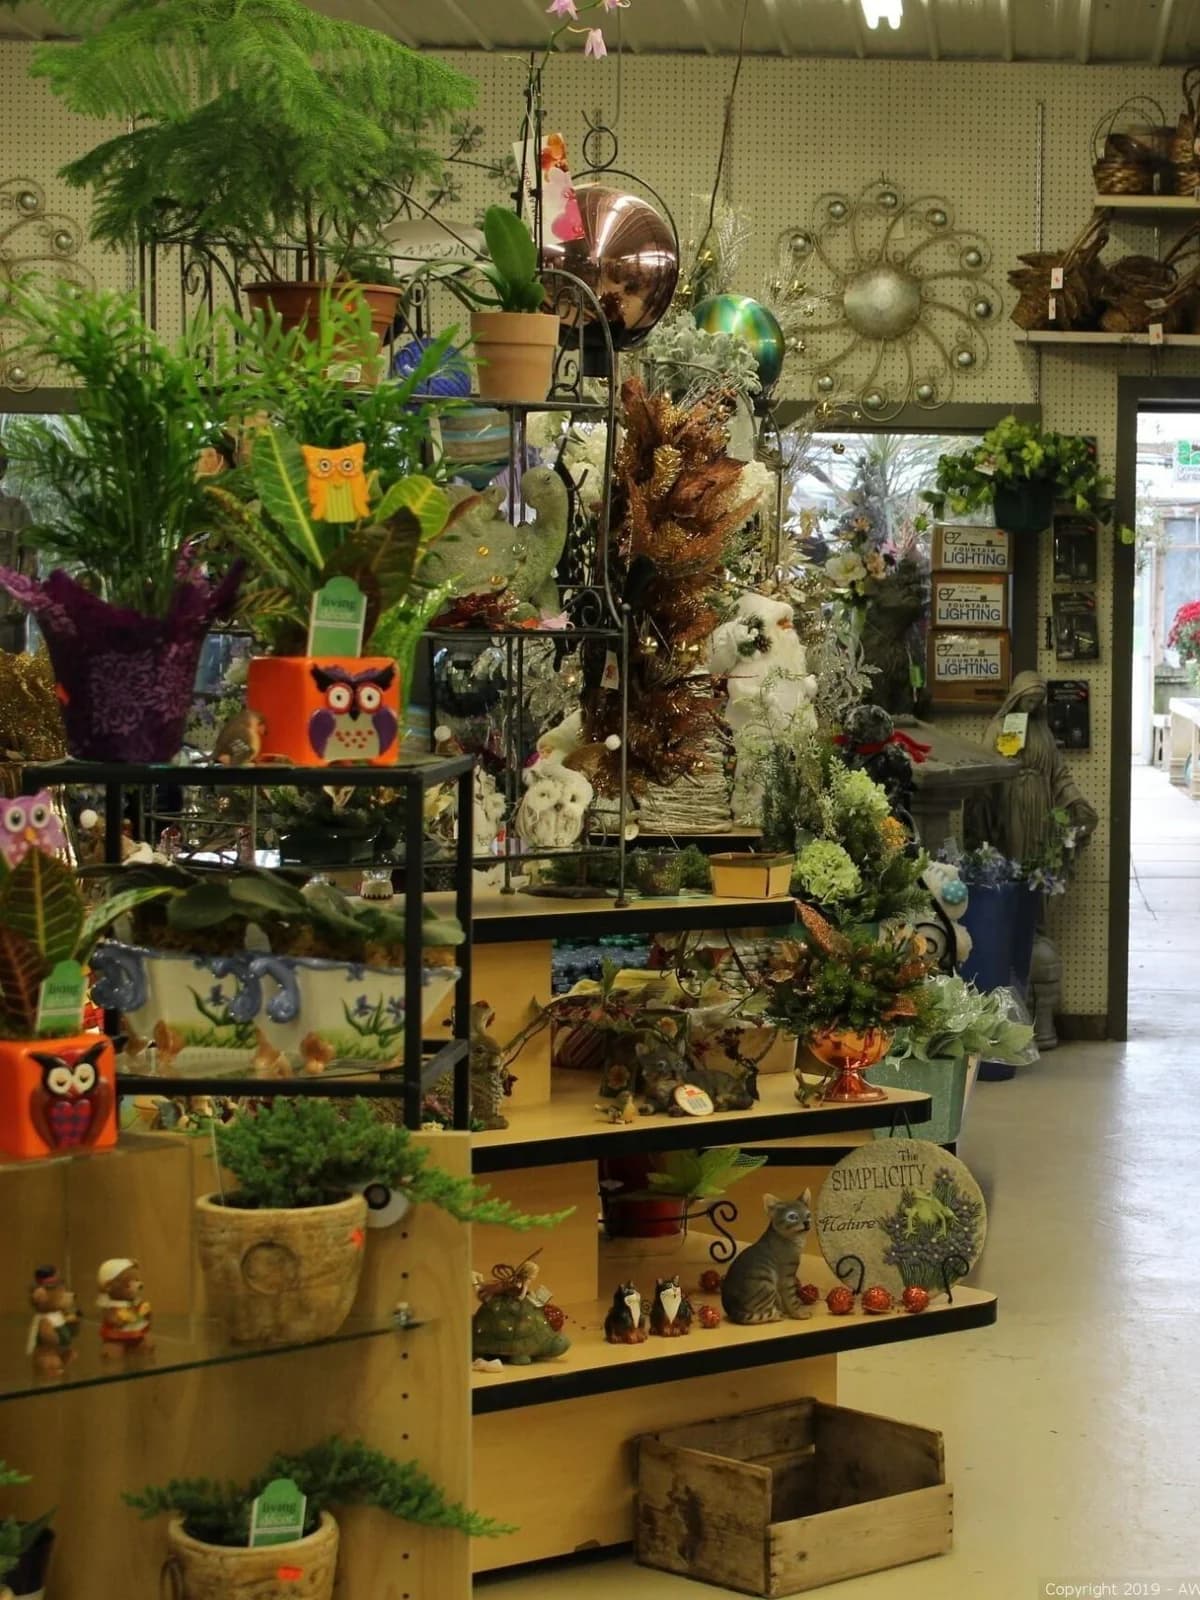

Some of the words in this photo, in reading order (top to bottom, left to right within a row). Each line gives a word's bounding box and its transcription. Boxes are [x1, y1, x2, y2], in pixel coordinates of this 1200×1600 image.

[944, 552, 1006, 566] LIGHTING
[938, 608, 1000, 621] LIGHTING
[937, 663, 999, 675] LIGHTING
[898, 1149, 918, 1161] The
[832, 1164, 926, 1191] SIMPLICITY
[819, 1216, 876, 1233] Nature
